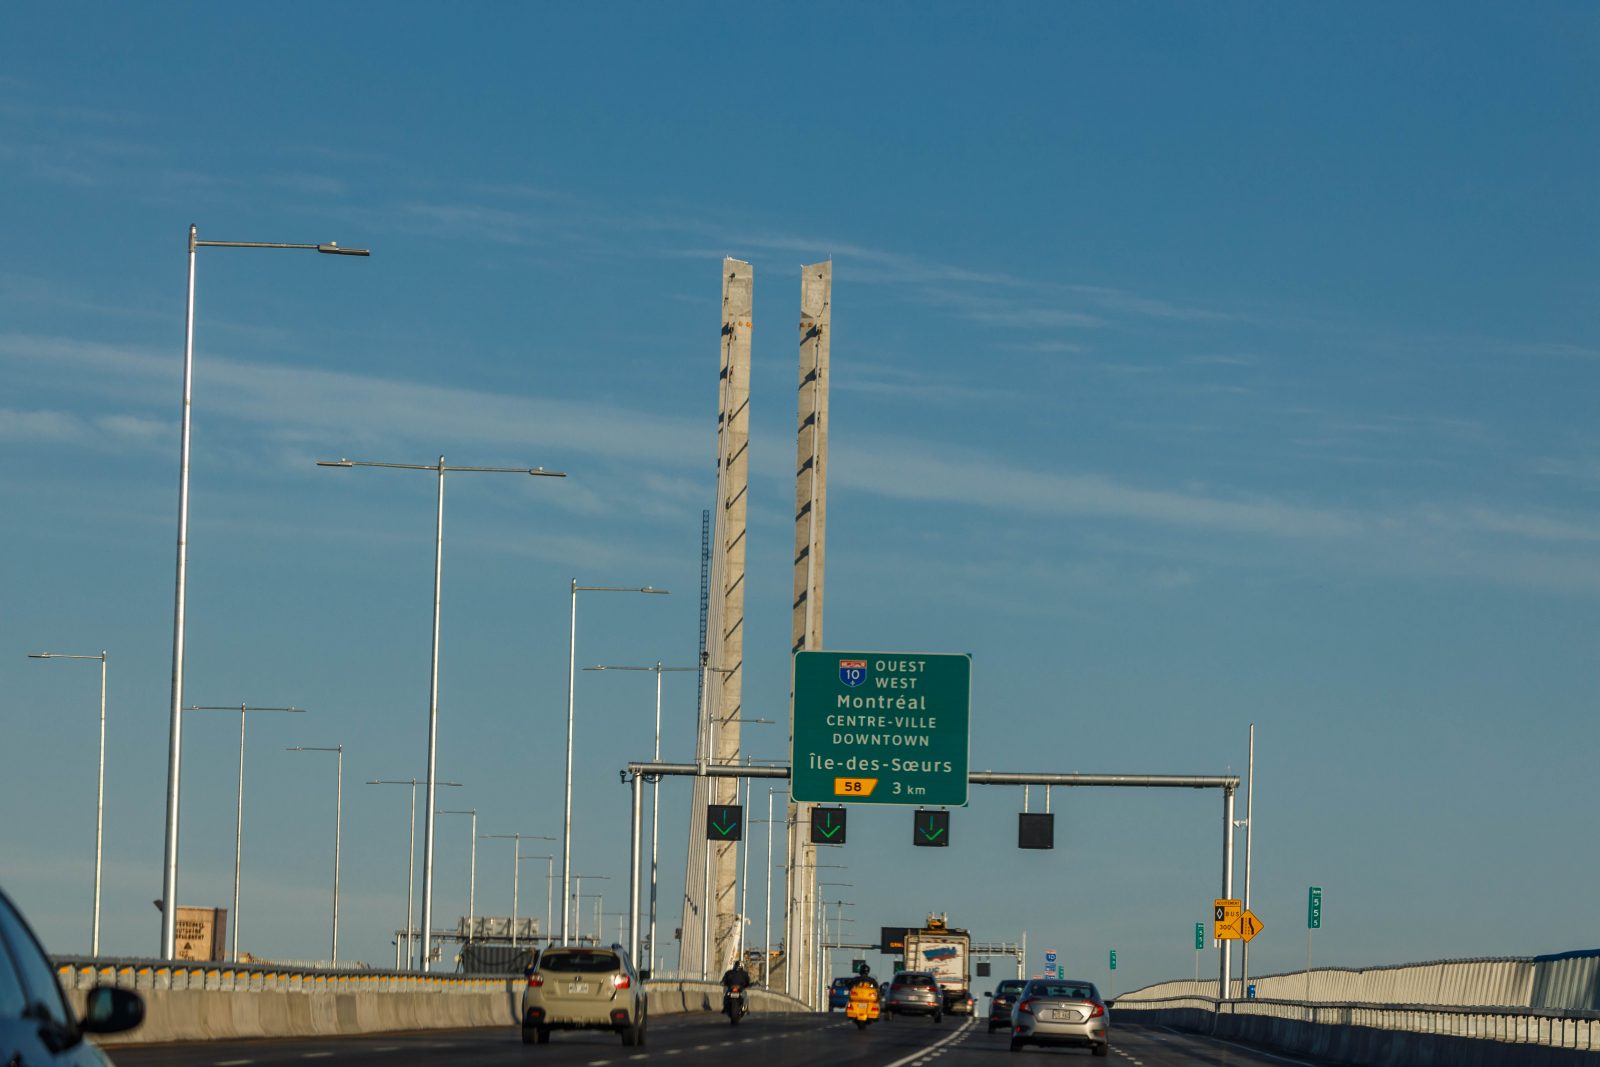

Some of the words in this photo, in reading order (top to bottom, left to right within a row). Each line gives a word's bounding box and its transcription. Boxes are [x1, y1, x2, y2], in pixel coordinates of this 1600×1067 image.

[875, 660, 926, 673] OUEST
[846, 669, 860, 680] 10
[875, 677, 918, 689] WEST
[837, 694, 926, 710] Montréal
[826, 714, 937, 729] CENTRE-VILLE
[832, 733, 930, 747] DOWNTOWN
[809, 752, 952, 773] Île-des-Sœurs
[844, 781, 862, 792] 58
[892, 781, 902, 795] 3
[907, 784, 926, 795] km
